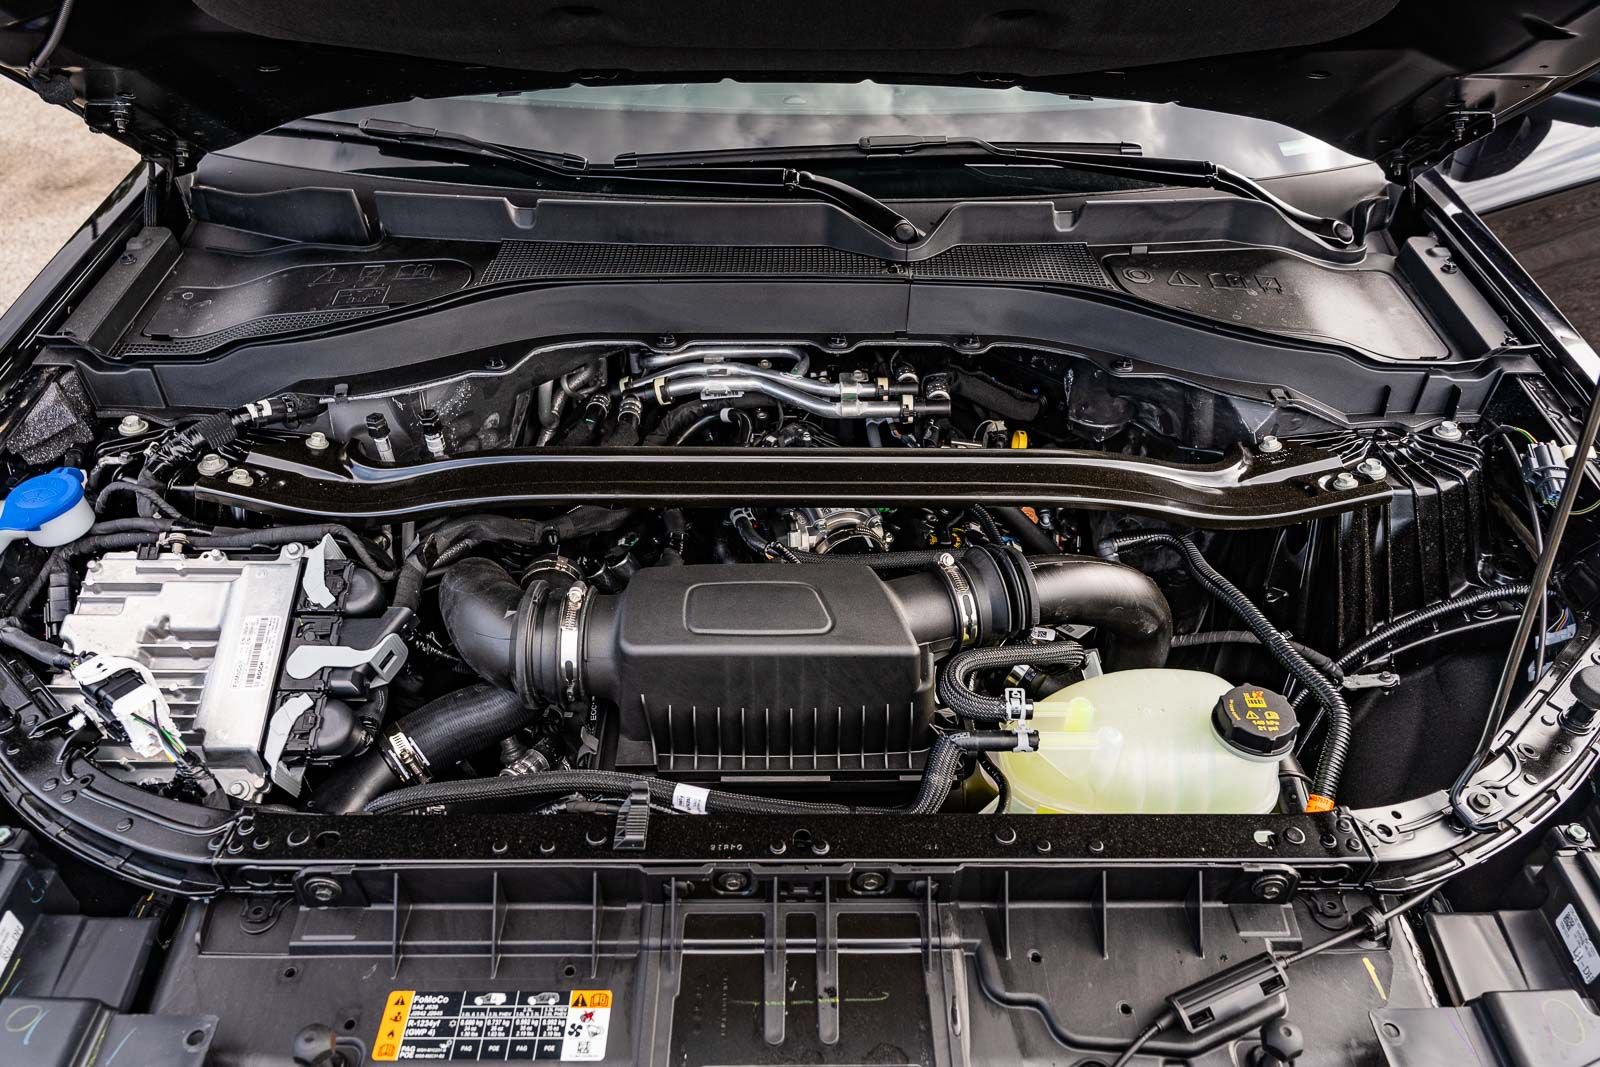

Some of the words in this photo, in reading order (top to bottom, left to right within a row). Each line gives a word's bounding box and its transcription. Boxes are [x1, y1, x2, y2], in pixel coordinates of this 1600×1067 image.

[413, 995, 449, 1004] FoMoCo
[407, 1019, 441, 1028] R-1234yf
[405, 1028, 428, 1037] (GWP
[428, 1028, 436, 1037] 4)
[399, 1051, 415, 1059] POE
